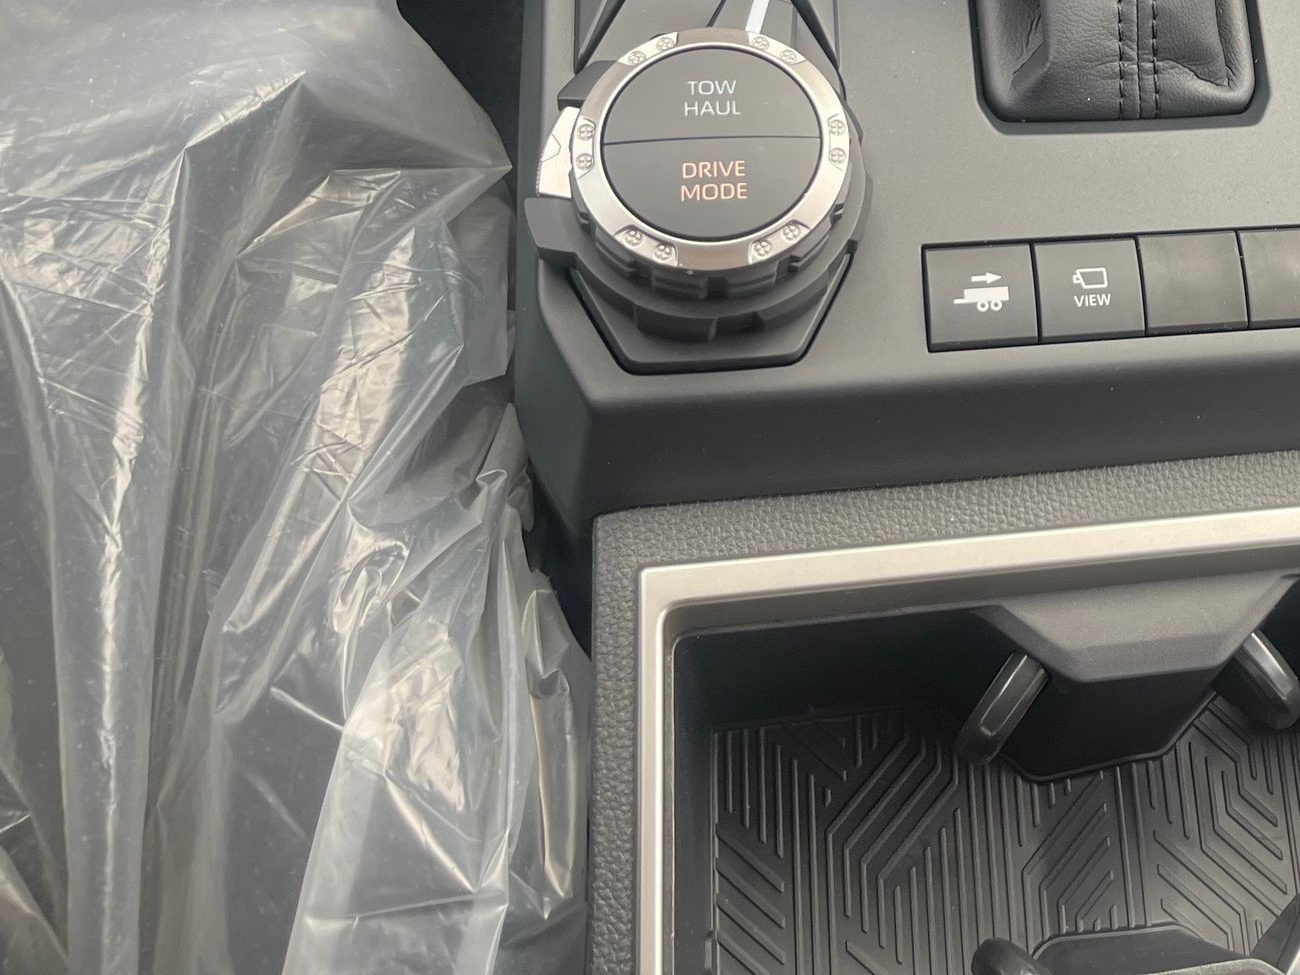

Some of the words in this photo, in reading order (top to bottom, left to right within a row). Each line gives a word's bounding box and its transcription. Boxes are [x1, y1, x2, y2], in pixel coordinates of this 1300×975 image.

[687, 79, 737, 96] TOW
[683, 100, 742, 117] HAUL
[681, 160, 746, 179] DRIVE
[680, 182, 748, 202] MODE
[1073, 293, 1111, 308] VIEW
